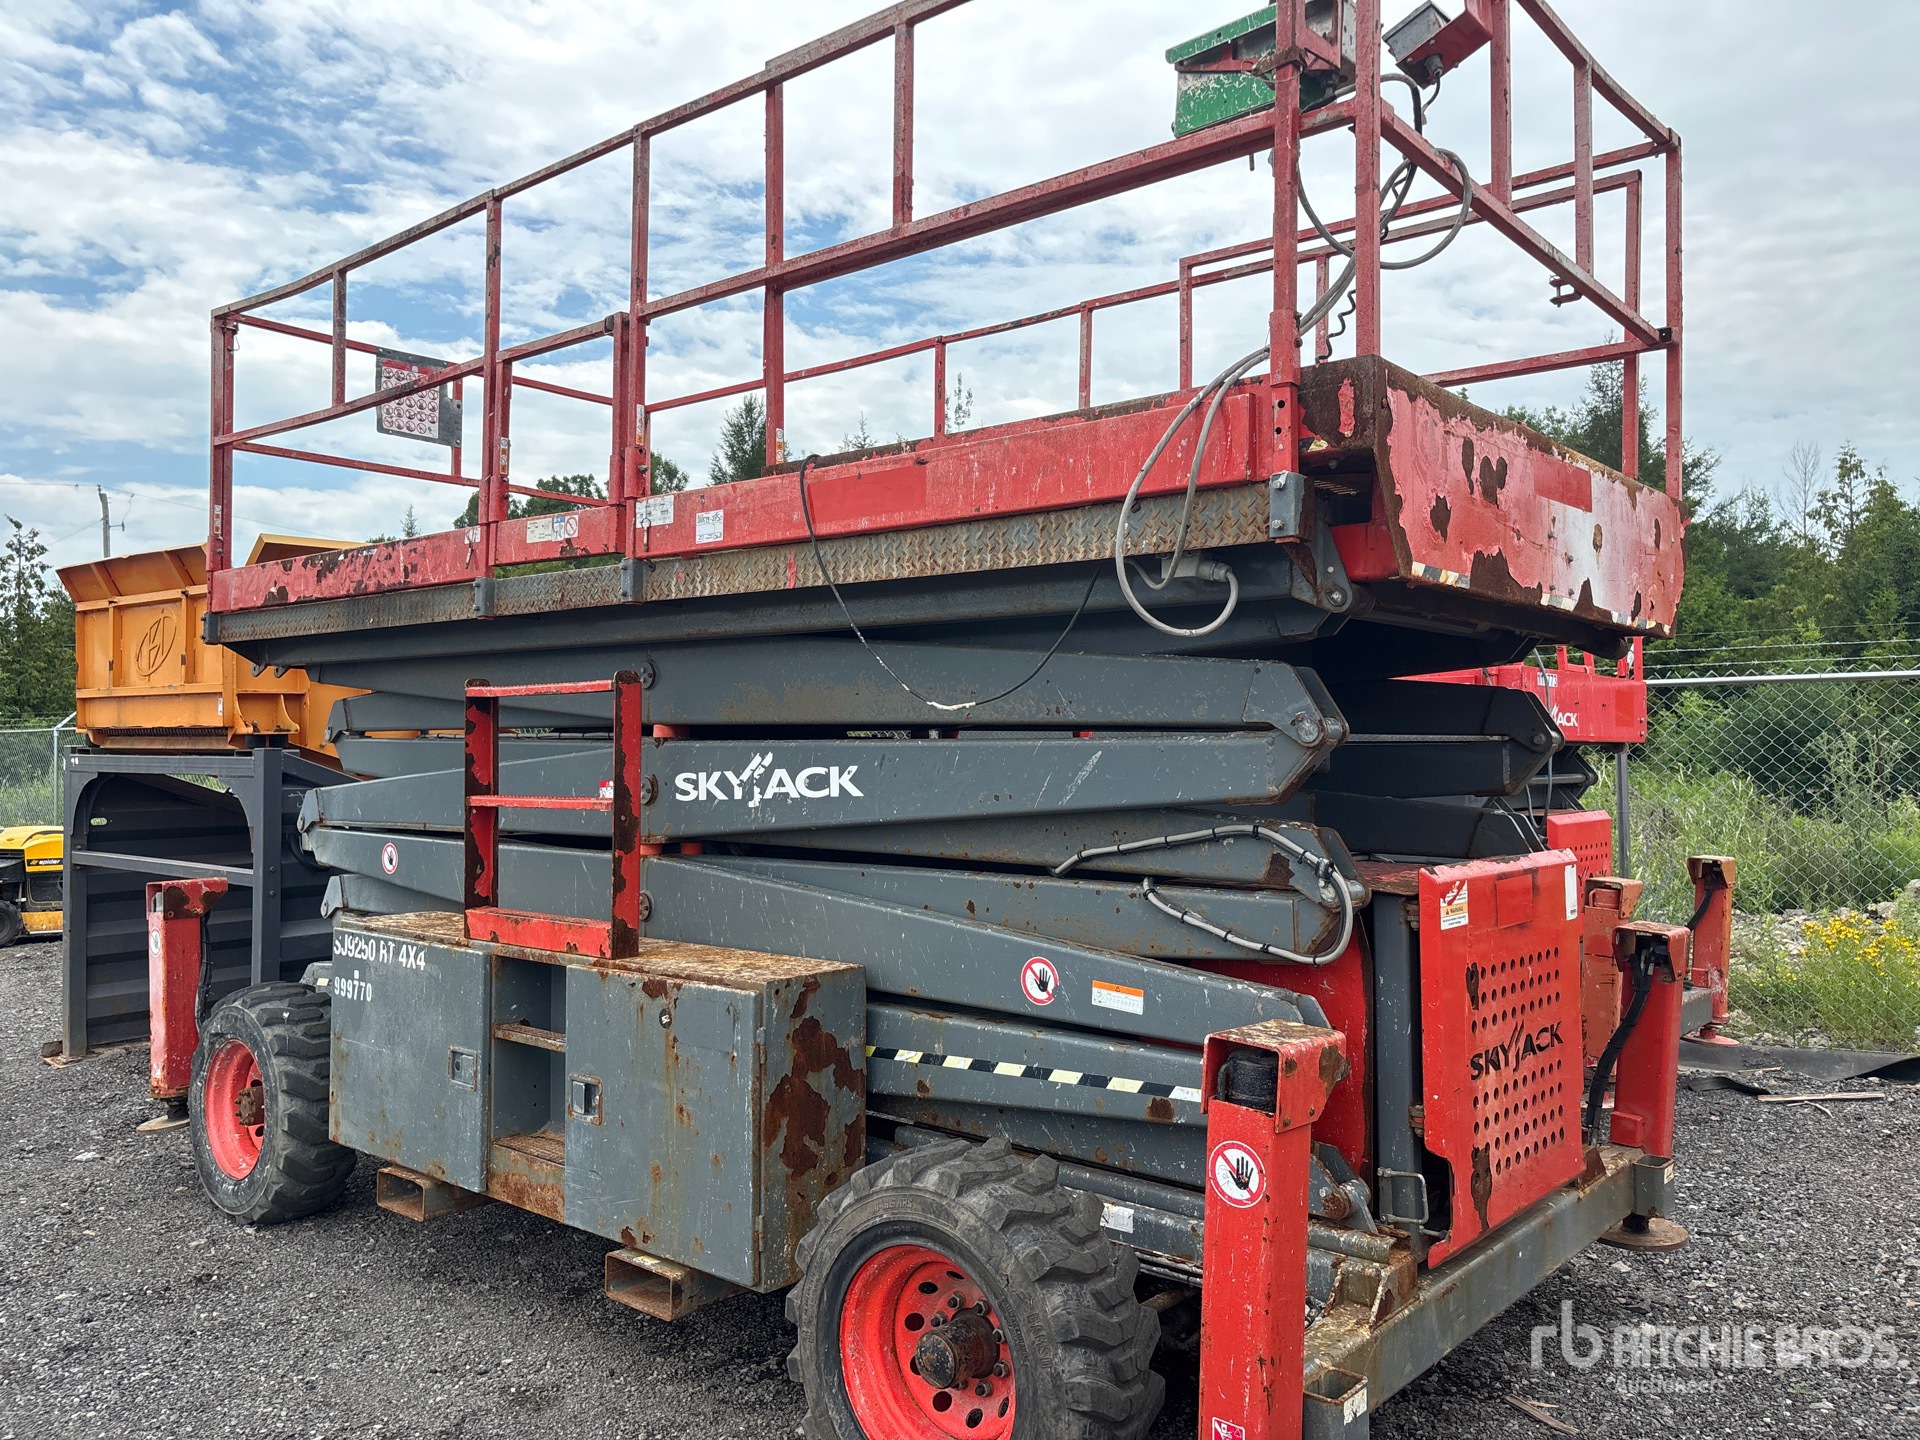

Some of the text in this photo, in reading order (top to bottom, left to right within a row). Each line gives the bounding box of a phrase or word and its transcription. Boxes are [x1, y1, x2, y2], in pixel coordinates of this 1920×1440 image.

[674, 751, 864, 808] SKYJACK
[334, 934, 426, 970] SJ9250 RT 4X4
[334, 976, 372, 1001] 999770
[1470, 1019, 1564, 1080] SKYJACK
